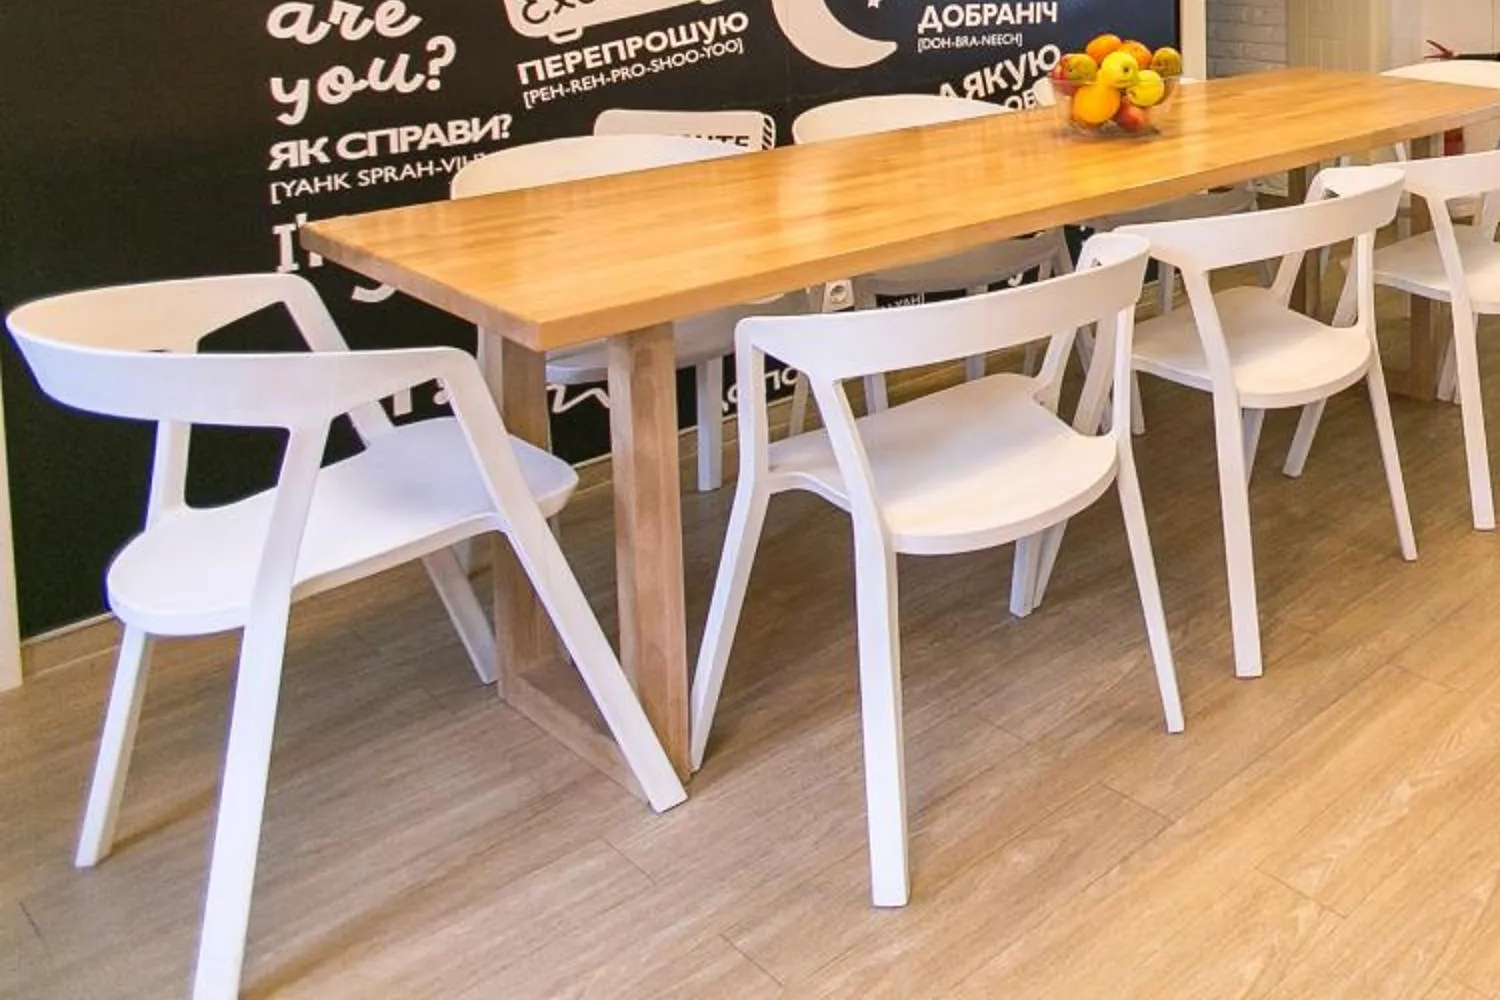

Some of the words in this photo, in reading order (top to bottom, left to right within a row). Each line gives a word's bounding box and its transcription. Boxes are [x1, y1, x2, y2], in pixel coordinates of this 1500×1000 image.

[517, 11, 749, 85] ПЕРЕПРОШУЮ
[917, 1, 1059, 34] ДОБРАНІЧ
[269, 35, 457, 126] you?
[268, 136, 332, 171] ЯК
[335, 113, 513, 160] СПРАВИ?
